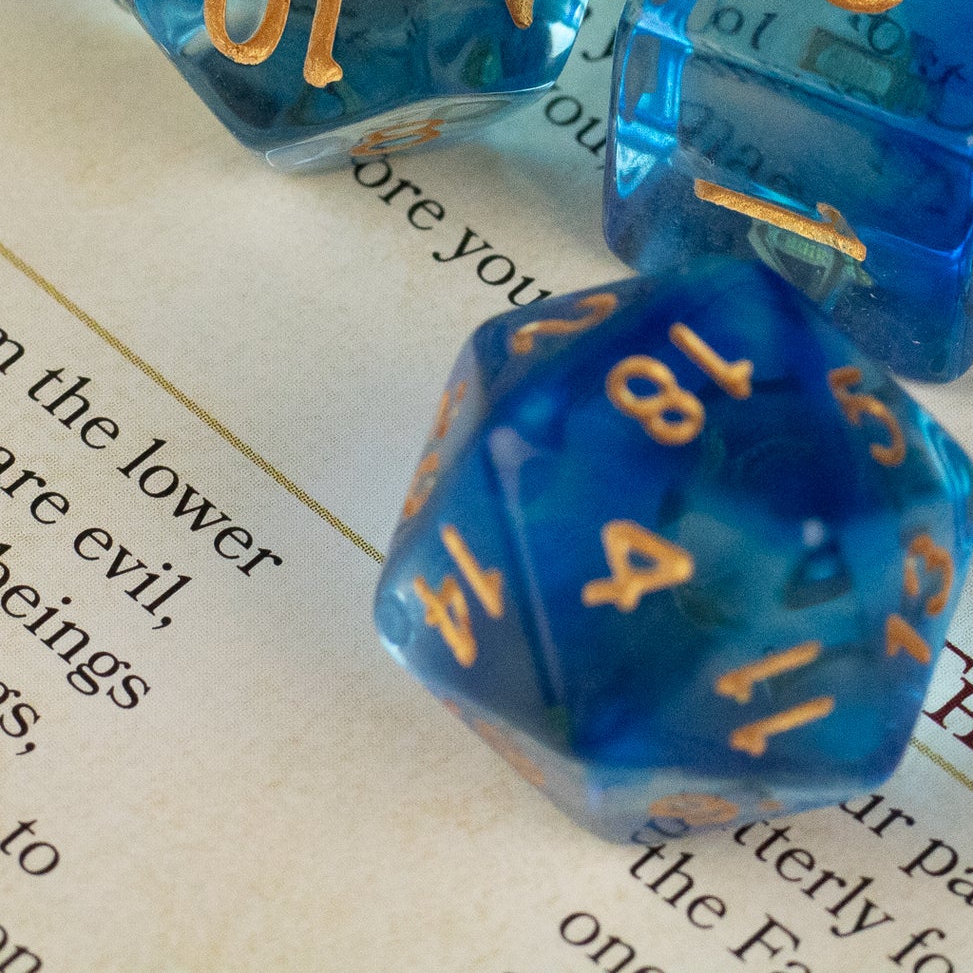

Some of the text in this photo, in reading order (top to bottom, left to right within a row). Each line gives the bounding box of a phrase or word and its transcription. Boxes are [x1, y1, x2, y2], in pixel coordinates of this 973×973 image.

[693, 178, 867, 261] 1
[606, 322, 755, 444] 18
[27, 368, 120, 450] the
[117, 438, 283, 577] lower
[73, 527, 192, 630] evil,
[581, 519, 693, 612] 4
[714, 640, 834, 756] 11
[0, 820, 60, 876] to
